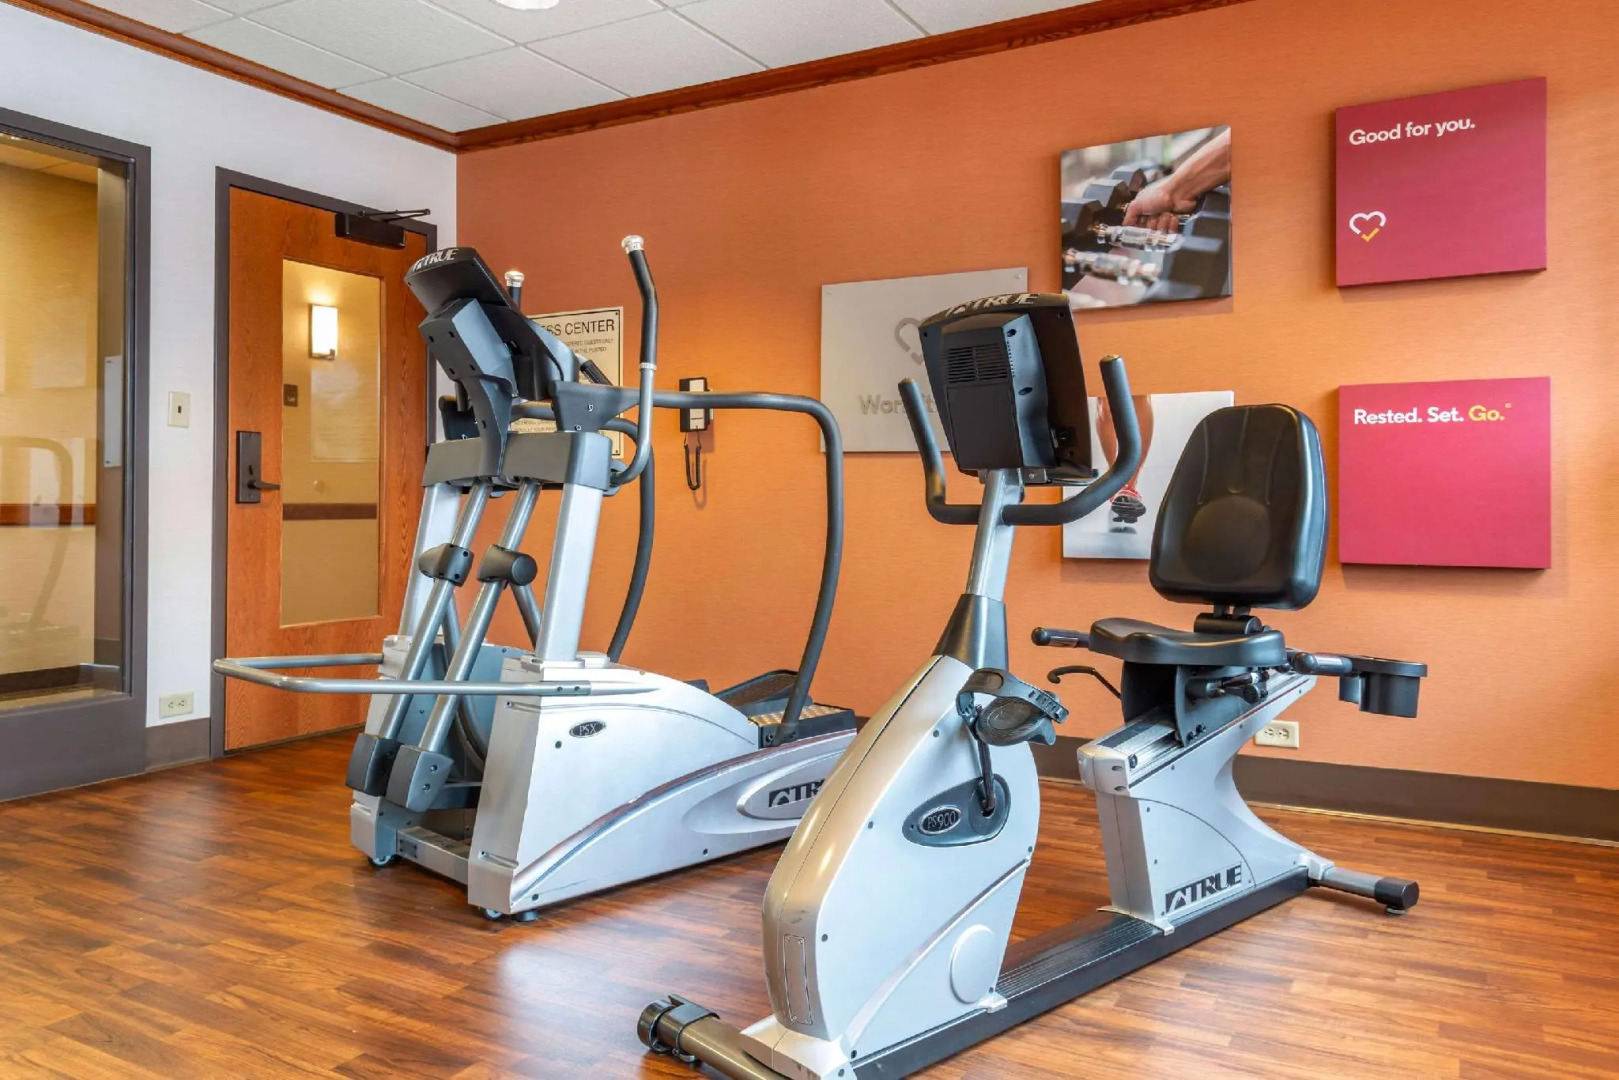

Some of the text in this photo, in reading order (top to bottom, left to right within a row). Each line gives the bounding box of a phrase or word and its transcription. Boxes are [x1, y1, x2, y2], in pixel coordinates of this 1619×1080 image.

[1348, 118, 1476, 146] Good for you.
[564, 318, 615, 336] CENTER
[857, 394, 907, 415] Wor
[1354, 407, 1423, 425] Rested.
[1427, 406, 1465, 423] Set.
